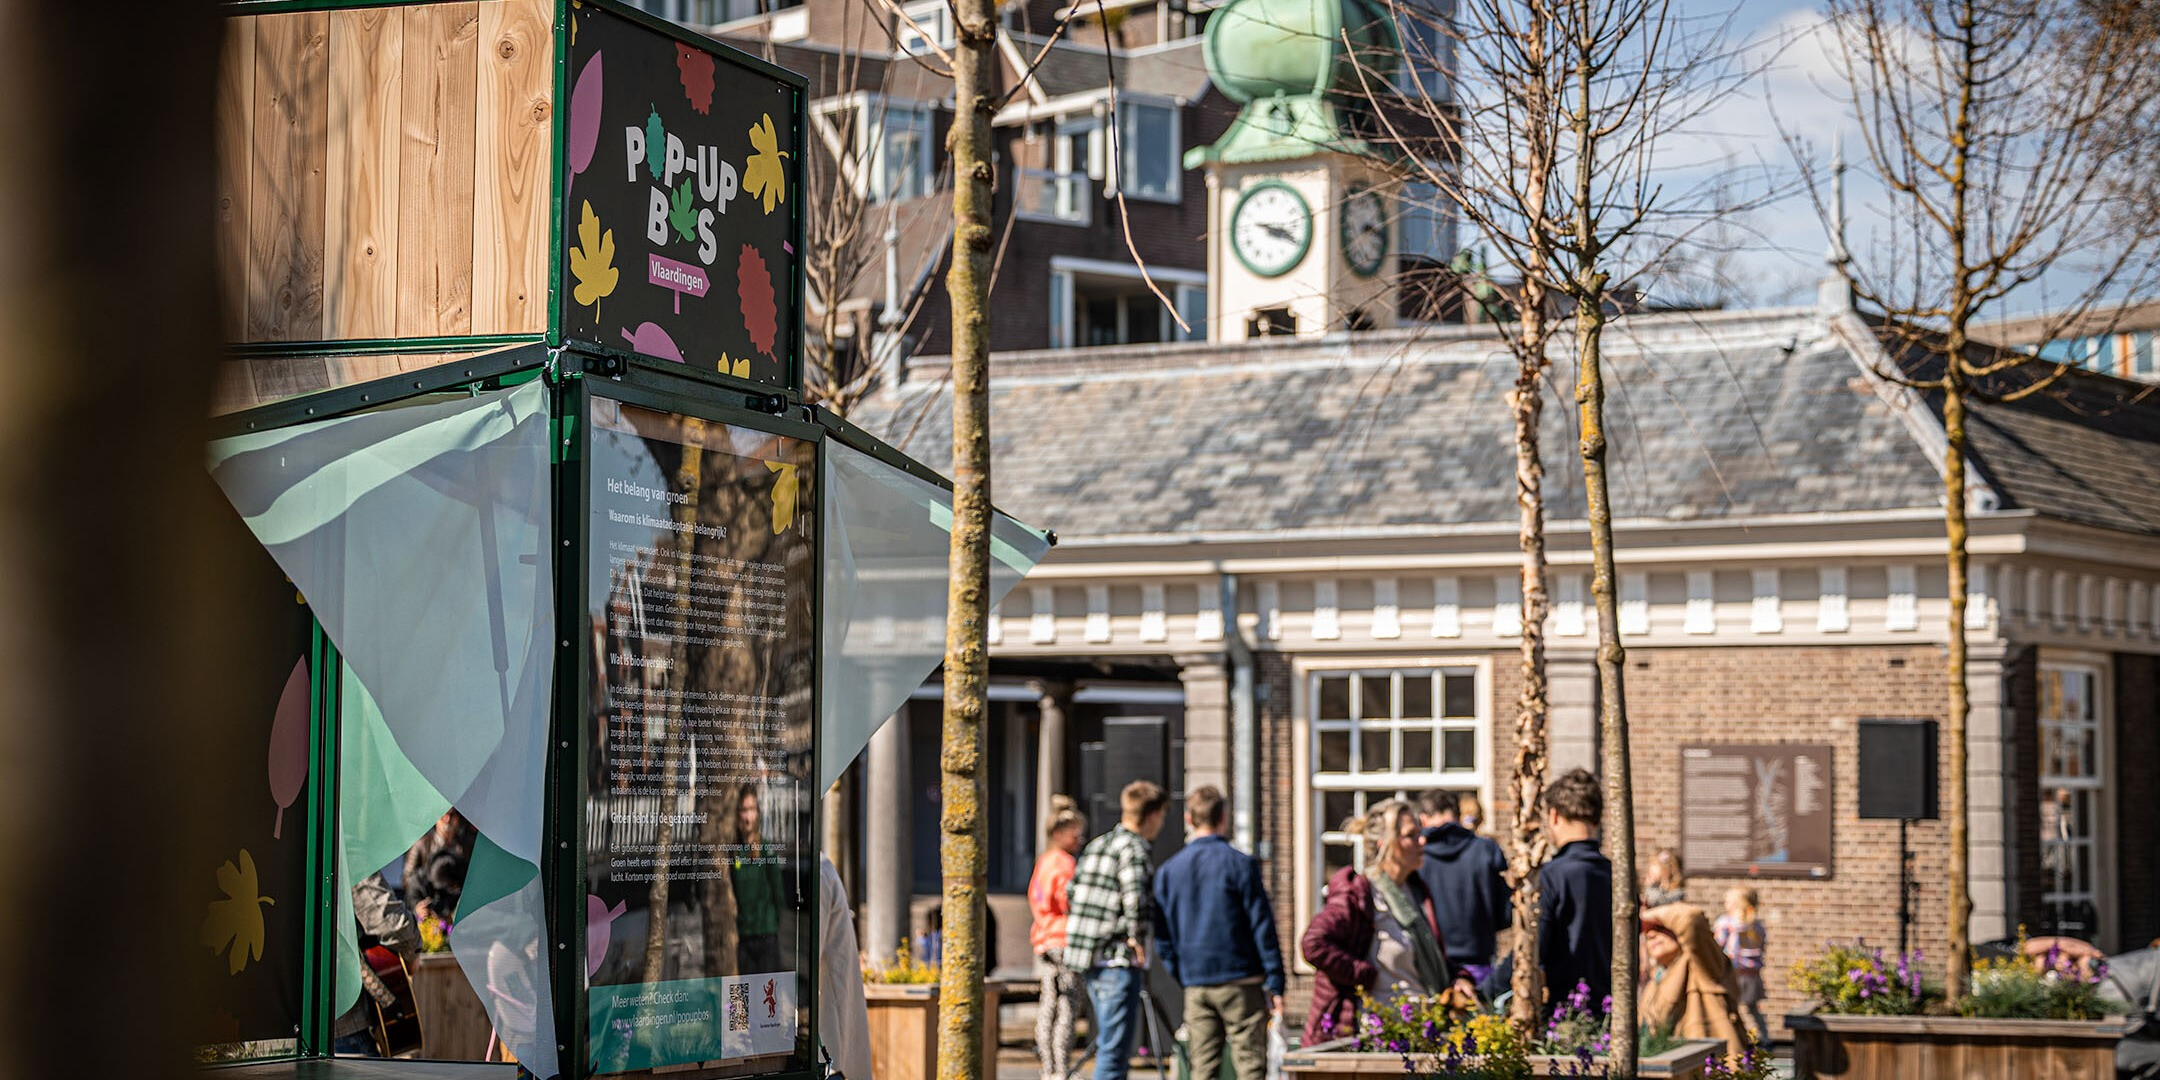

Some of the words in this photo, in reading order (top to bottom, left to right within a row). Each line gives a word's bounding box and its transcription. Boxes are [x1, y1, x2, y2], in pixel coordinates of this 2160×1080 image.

[651, 260, 704, 291] Vlaardingen
[607, 477, 623, 494] Het
[624, 480, 649, 501] belang
[651, 488, 665, 501] van
[666, 491, 688, 507] groen
[608, 508, 635, 524] Waarom
[636, 513, 641, 525] is
[642, 514, 693, 536] klimaatadaptatie
[694, 522, 726, 540] belangrijk?
[665, 604, 679, 614] Groen
[610, 652, 623, 665] Wat
[623, 653, 629, 665] is
[629, 654, 673, 669] biodiversiteit?
[610, 811, 630, 823] Groen
[632, 812, 648, 826] helpt
[649, 812, 658, 826] bij
[659, 812, 667, 823] de
[668, 812, 707, 826] gezondheid!
[621, 845, 638, 854] groene
[639, 843, 665, 854] omgeving
[667, 843, 683, 853] nodigt
[610, 857, 626, 867] Groen
[624, 872, 643, 881] Kortom
[612, 994, 629, 1007] Meer
[629, 992, 652, 1006] weten?
[653, 990, 673, 1004] Check
[675, 989, 688, 1002] dan:
